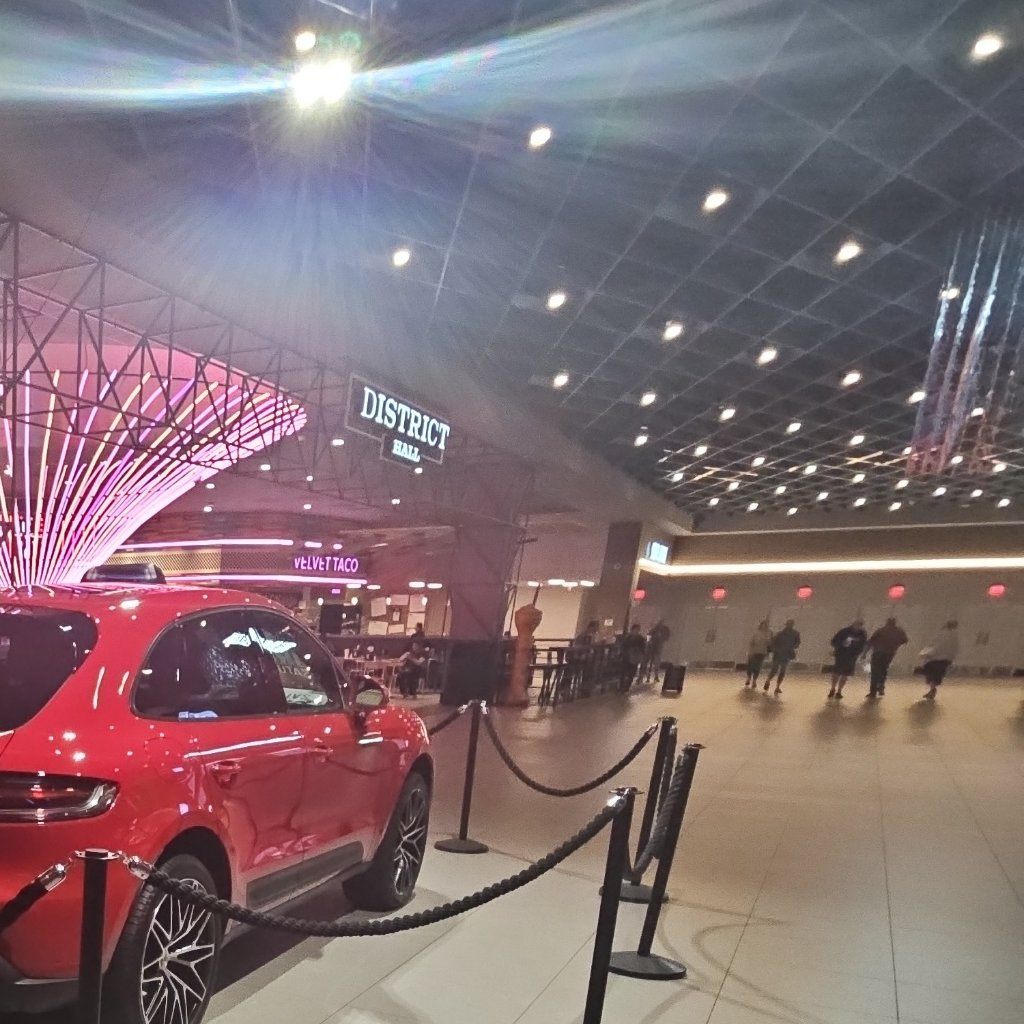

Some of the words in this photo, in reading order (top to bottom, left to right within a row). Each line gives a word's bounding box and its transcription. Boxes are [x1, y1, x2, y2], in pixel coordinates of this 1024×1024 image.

[360, 386, 451, 450] DISTRICT
[392, 438, 421, 463] HALL
[294, 555, 331, 571] VELVET
[333, 556, 359, 573] TACO
